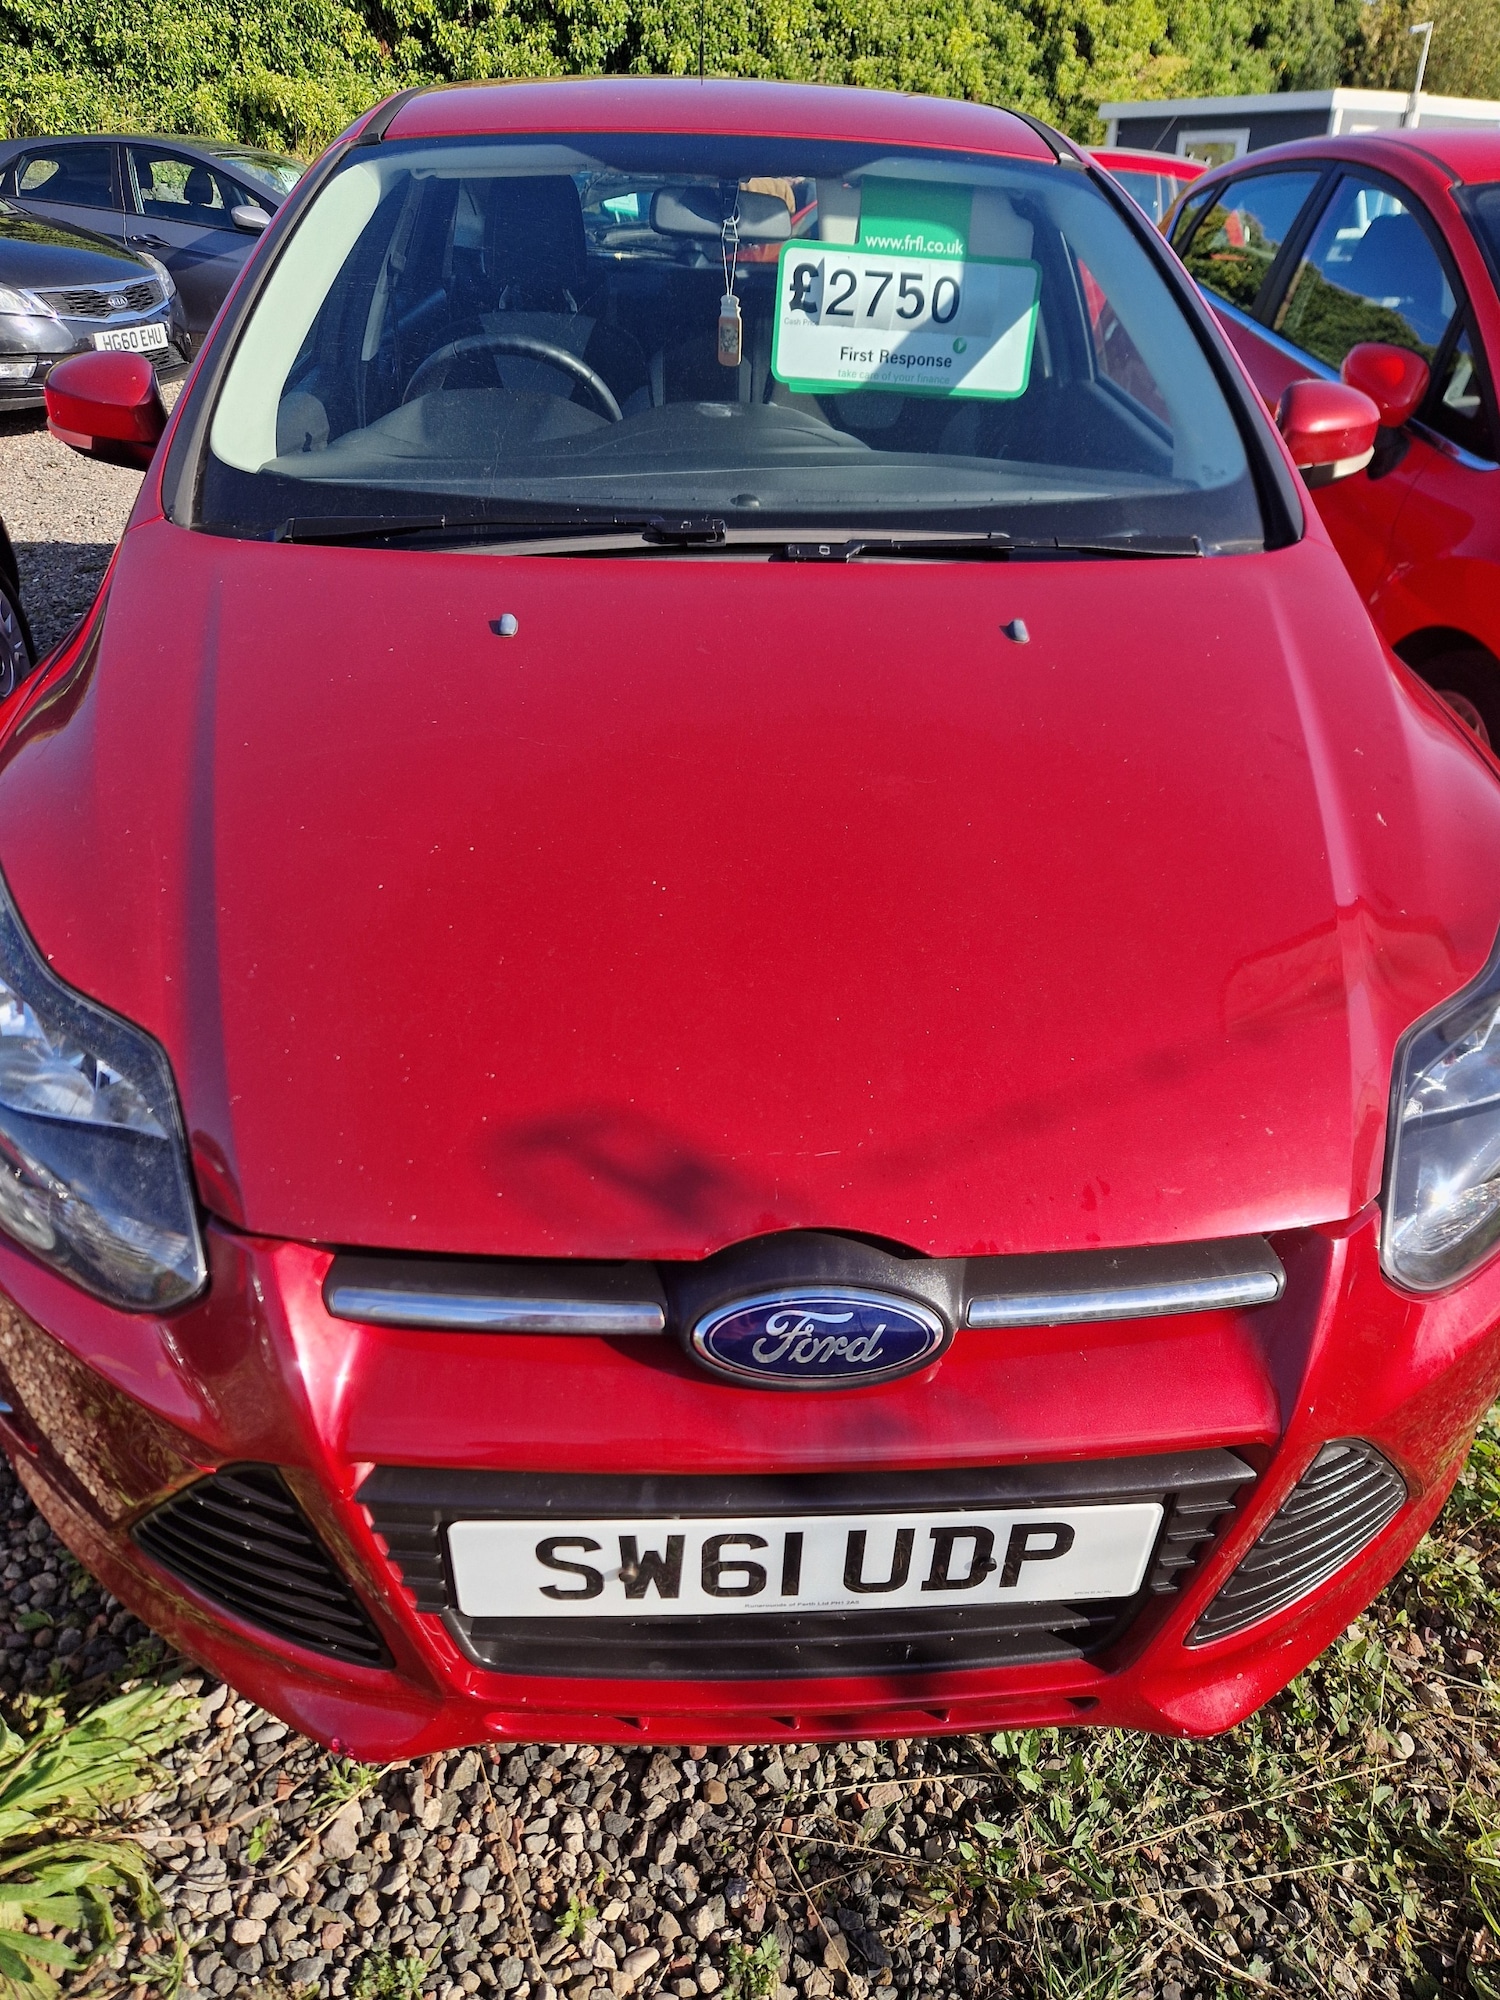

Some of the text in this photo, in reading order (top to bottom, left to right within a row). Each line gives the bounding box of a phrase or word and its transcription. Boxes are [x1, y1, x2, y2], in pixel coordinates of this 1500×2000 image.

[865, 234, 963, 255] www.frfl.co.uk
[789, 263, 960, 324] £2750
[784, 317, 801, 325] Cash
[103, 327, 162, 350] HG60 EHU
[840, 346, 952, 368] First Response
[838, 369, 950, 385] take care of your finance
[752, 1309, 887, 1364] Ford
[536, 1522, 1076, 1600] SW61 UDP
